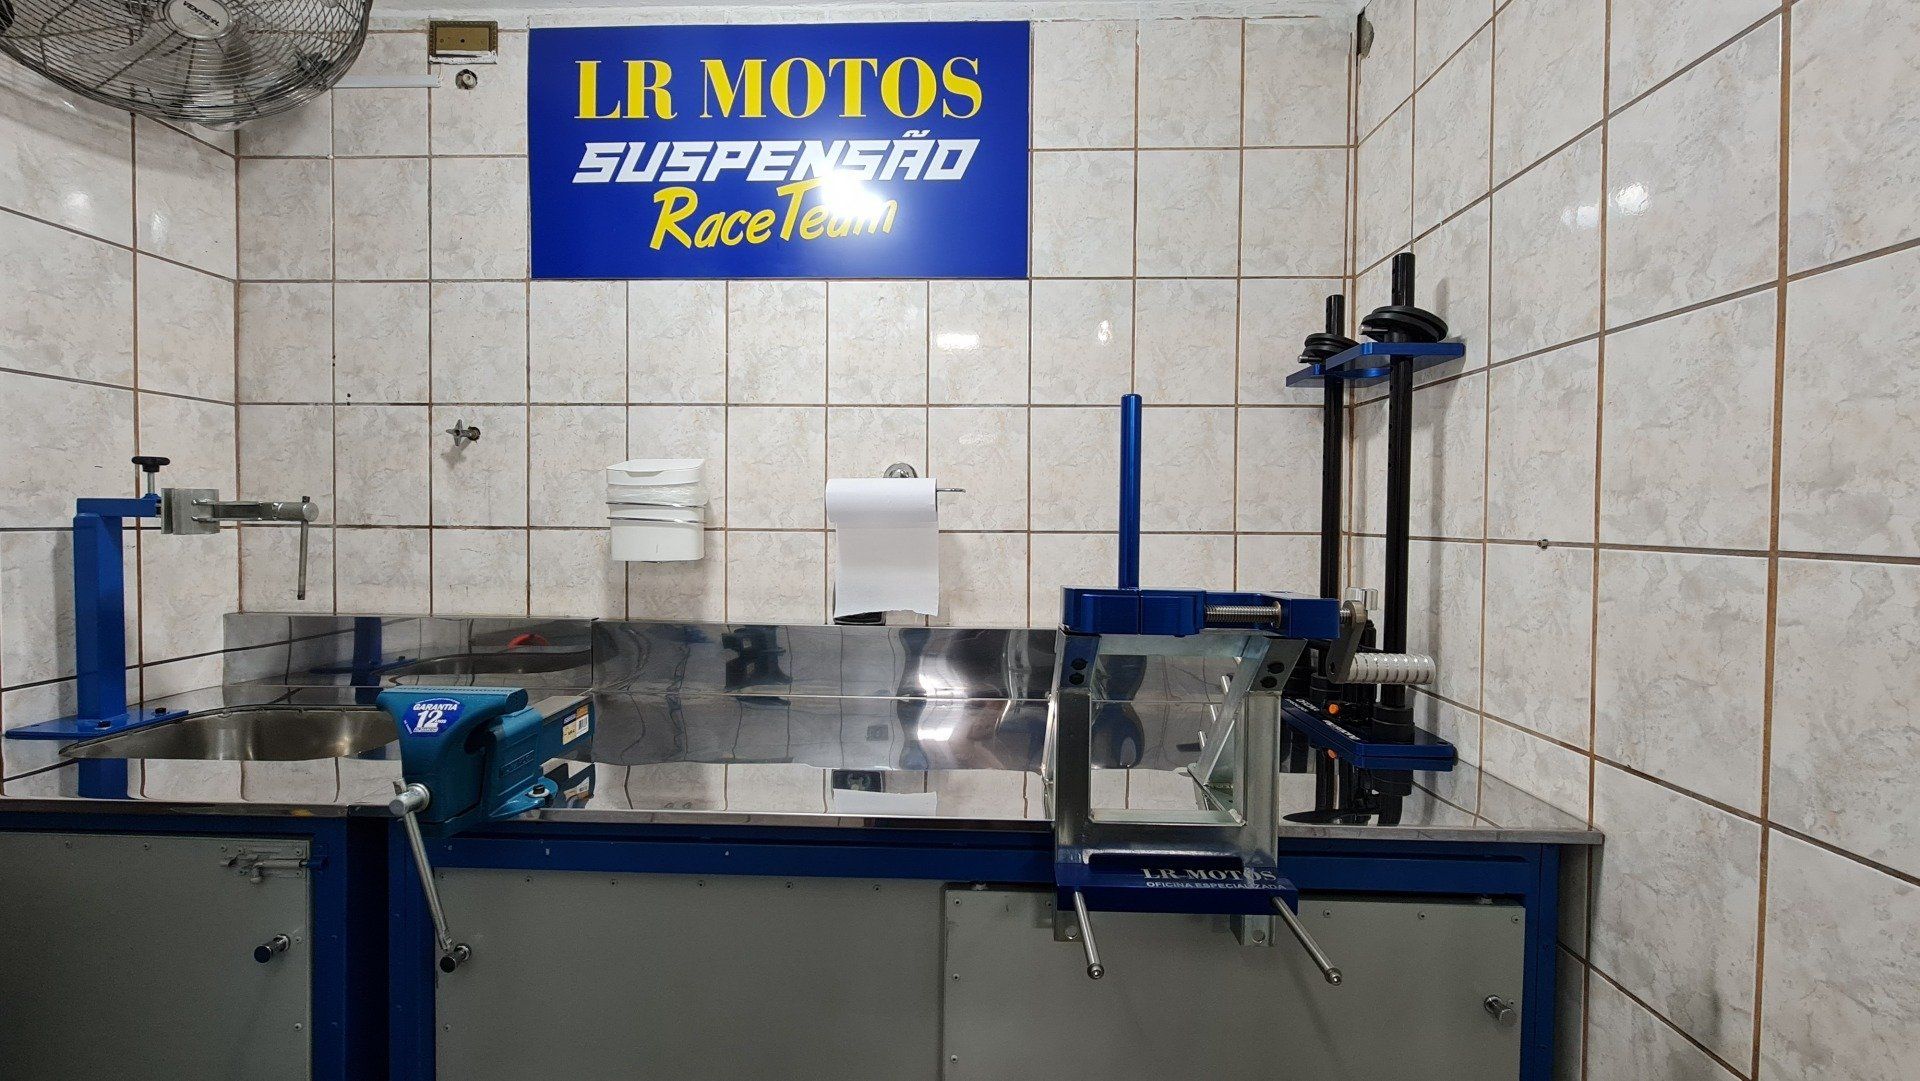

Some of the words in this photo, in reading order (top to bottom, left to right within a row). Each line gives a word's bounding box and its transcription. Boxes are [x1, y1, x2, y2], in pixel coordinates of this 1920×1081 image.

[573, 59, 678, 120] LR
[700, 56, 983, 119] MOTOS
[572, 129, 981, 183] SUSPENSÃO
[649, 186, 776, 250] Race
[413, 703, 458, 711] GARANTIA
[416, 710, 443, 728] 12
[1141, 868, 1180, 879] LR
[1183, 868, 1277, 881] MOTOS
